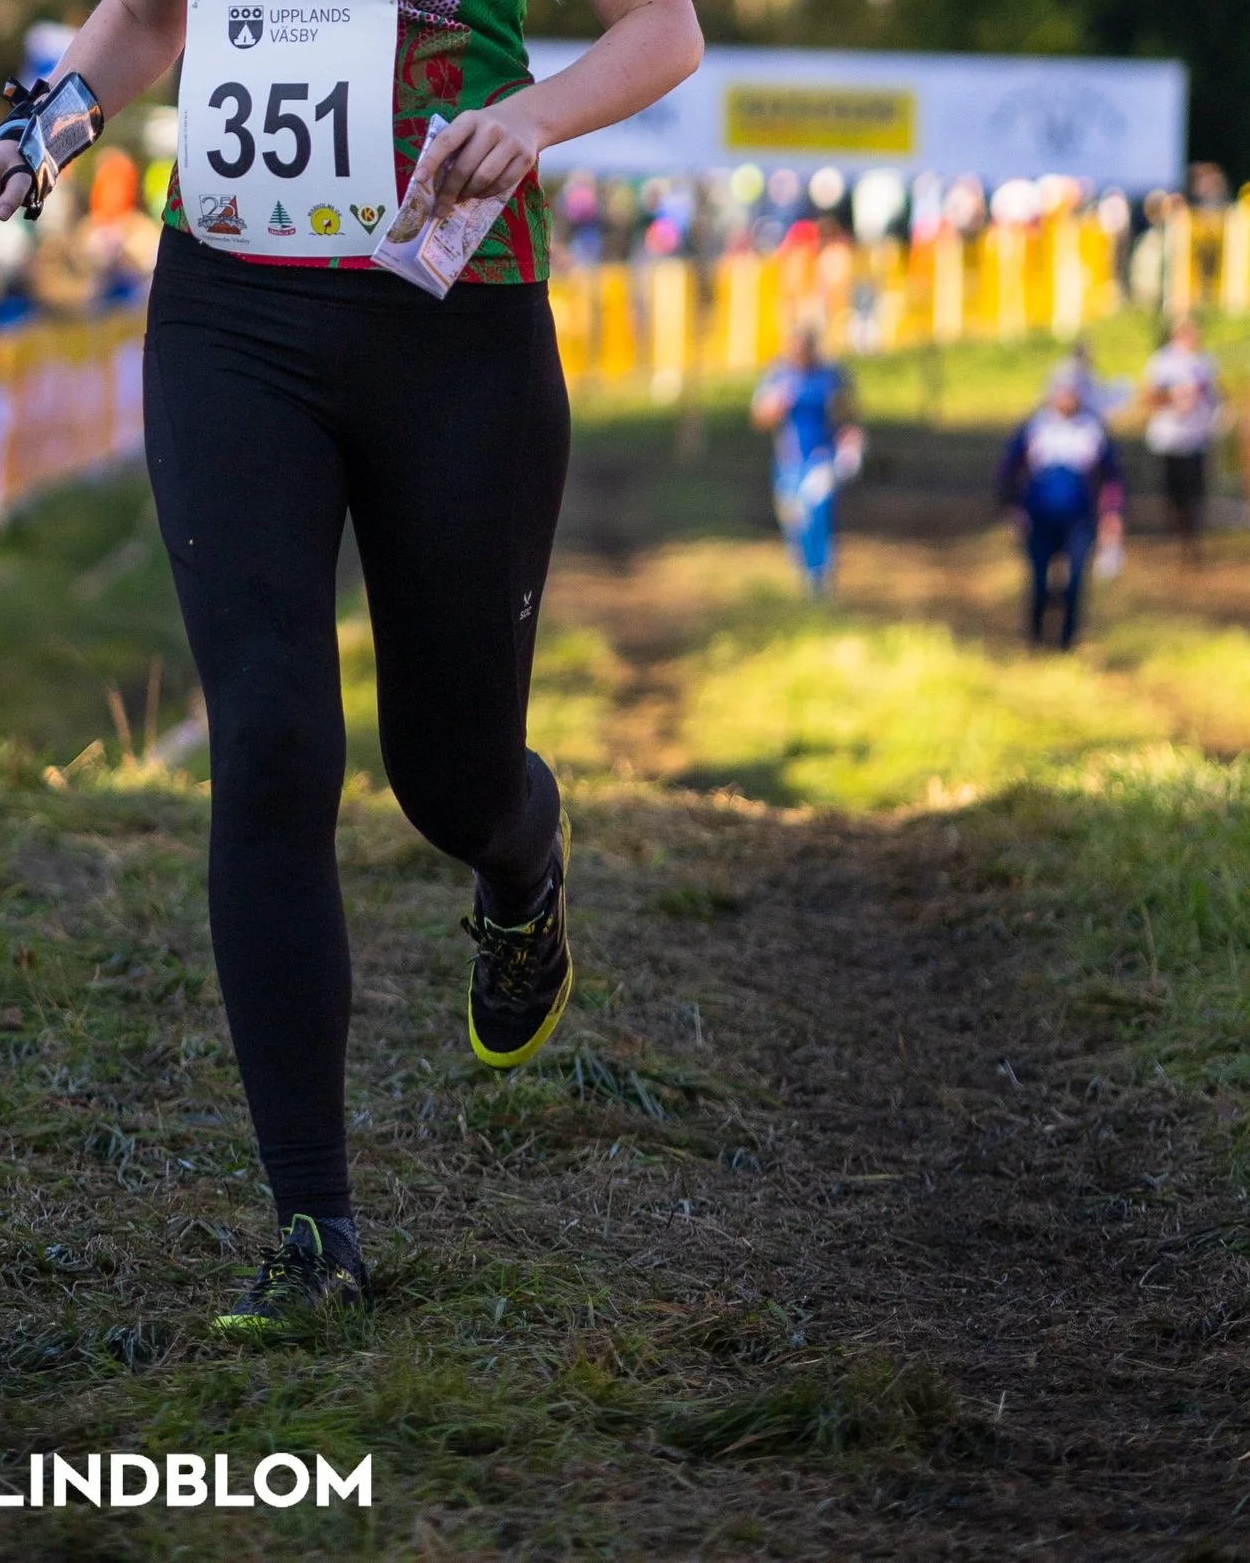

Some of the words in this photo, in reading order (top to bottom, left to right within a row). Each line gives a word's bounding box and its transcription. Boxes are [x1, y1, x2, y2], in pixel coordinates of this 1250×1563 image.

[269, 8, 351, 24] UPPLANDS
[269, 26, 319, 43] VÄSBY
[206, 81, 351, 179] 351
